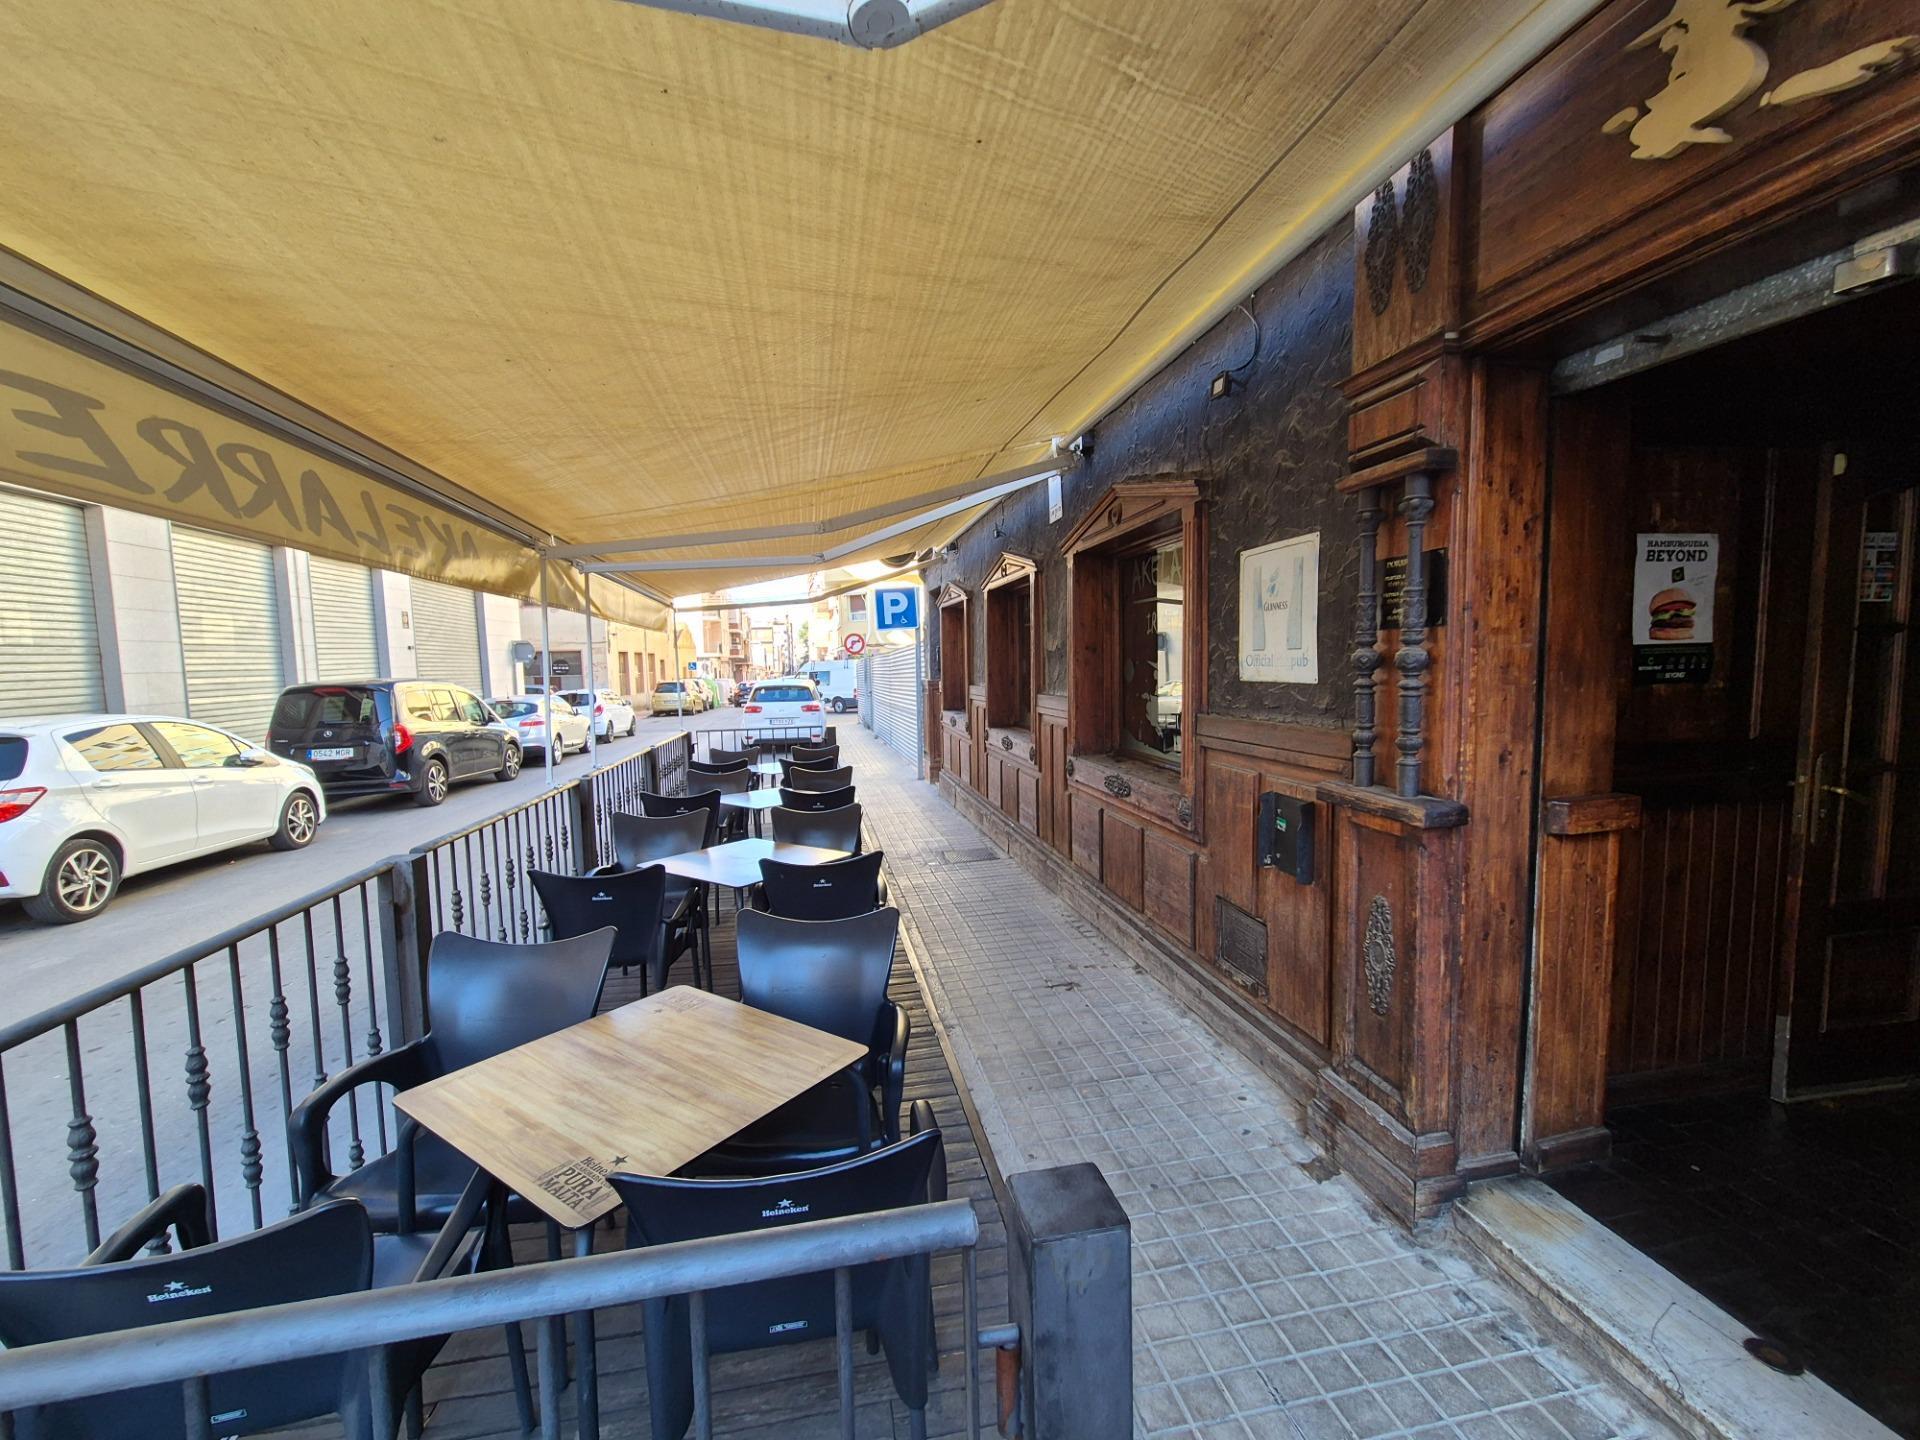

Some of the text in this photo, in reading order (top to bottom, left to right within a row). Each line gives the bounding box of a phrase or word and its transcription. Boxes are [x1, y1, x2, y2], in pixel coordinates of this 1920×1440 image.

[1647, 540, 1709, 548] HAMBURGUESA
[1646, 549, 1708, 562] BEYOND
[883, 592, 908, 624] P
[1264, 600, 1288, 612] GUINNESS
[313, 748, 351, 758] 0542 MGR
[553, 1167, 603, 1200] PURA
[543, 1178, 585, 1210] MALTA
[762, 1205, 809, 1217] Heineken
[147, 1286, 212, 1302] Heineken
